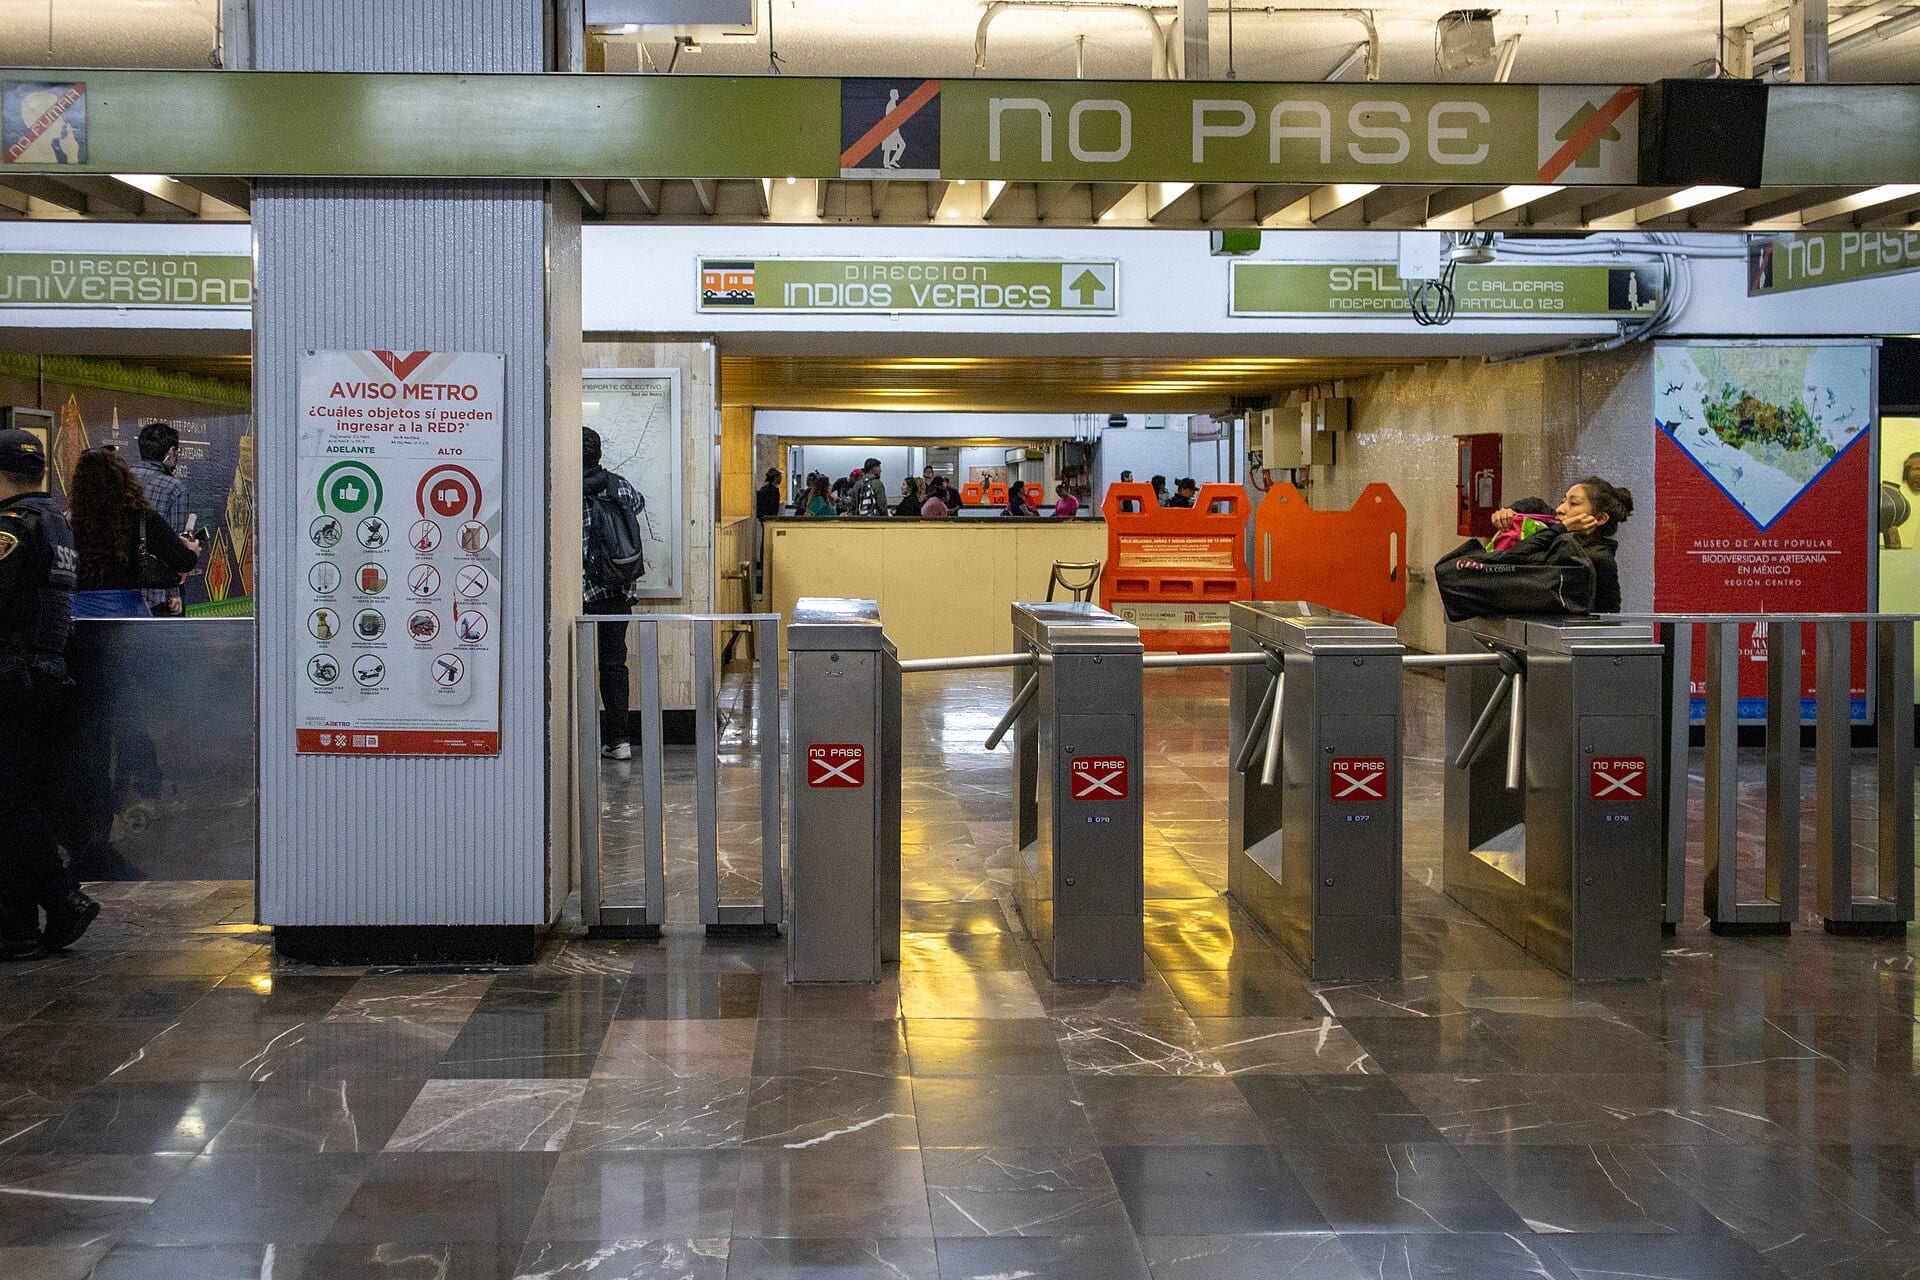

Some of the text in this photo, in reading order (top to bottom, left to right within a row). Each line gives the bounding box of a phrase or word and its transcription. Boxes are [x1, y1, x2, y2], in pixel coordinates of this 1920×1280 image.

[9, 89, 80, 158] NO FUMAR
[989, 98, 1490, 165] NO PASE
[1788, 236, 1825, 280] NO
[51, 260, 198, 276] DIRECCION
[846, 265, 987, 281] DIRECCION
[784, 283, 1051, 308] INDIOS VERDES
[1460, 298, 1564, 309] ARTICULO 123
[329, 381, 479, 401] AVISO METRO
[309, 406, 493, 421] ¿Cuáles objetos sí pueden
[337, 420, 394, 433] ingresar
[398, 424, 406, 432] a
[411, 422, 423, 433] la
[326, 446, 376, 454] ADELANTE
[437, 448, 463, 456] ALTO
[1694, 540, 1833, 548] MUSEO DE ARTE POPULAR
[1702, 555, 1769, 564] BIODIVERSIDAD
[1779, 553, 1827, 563] ARTESANÍA
[1738, 564, 1791, 575] EN MÉXICO
[1724, 578, 1761, 586] REGIÓN
[809, 749, 862, 757] NO PASE
[1073, 761, 1125, 770] NO PASE
[1333, 762, 1385, 771] NO PASE
[1593, 761, 1645, 770] NO PASE
